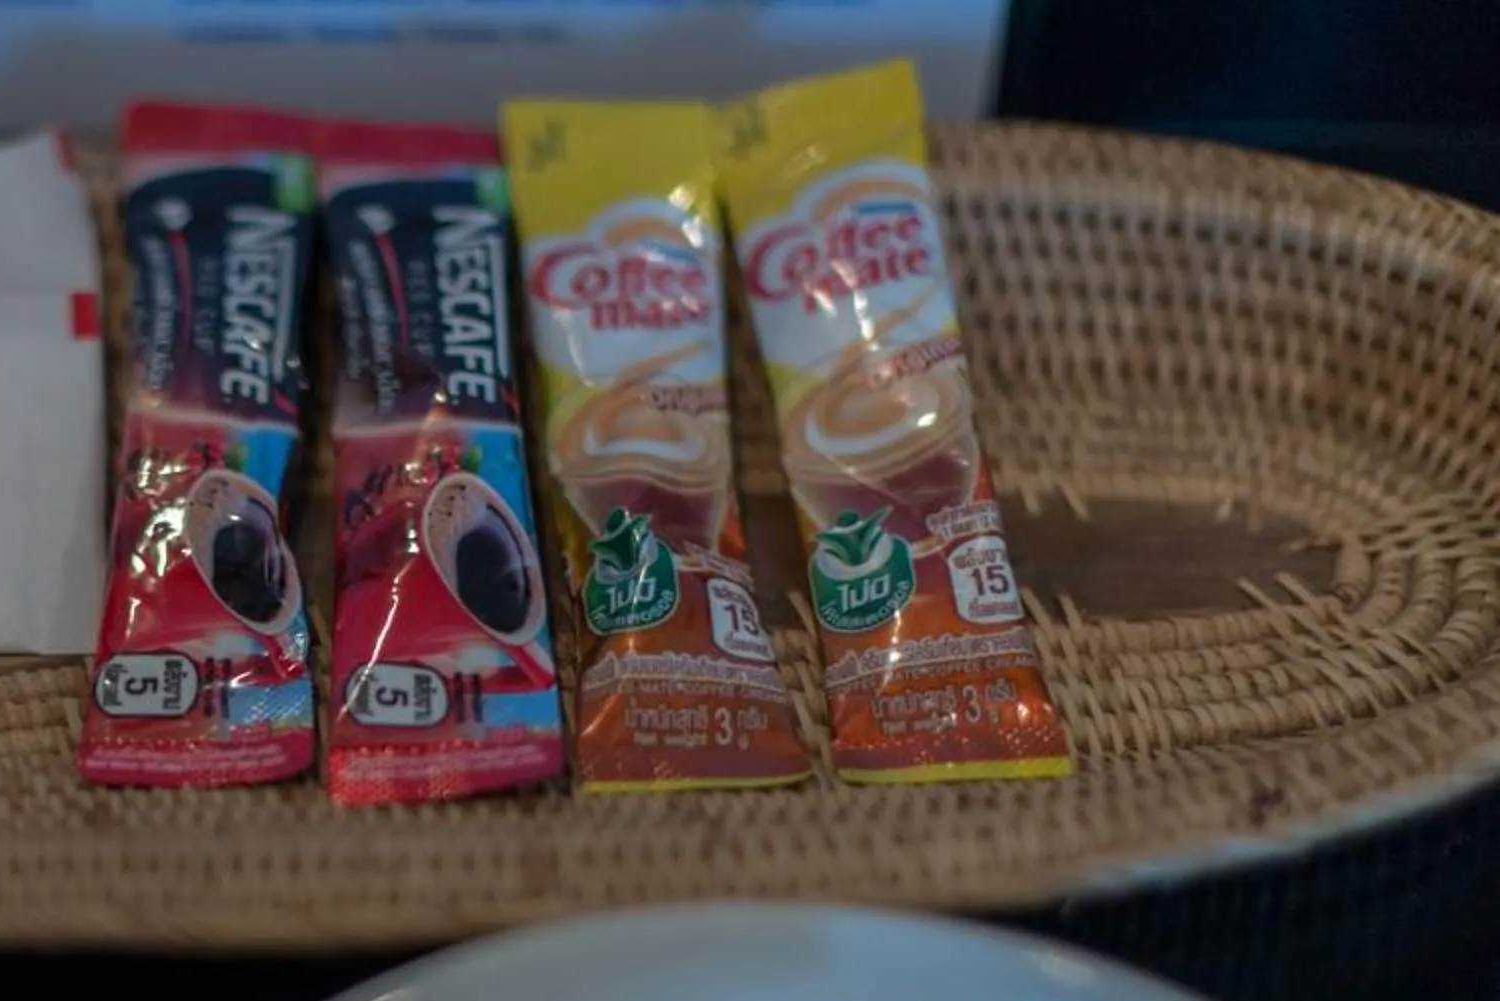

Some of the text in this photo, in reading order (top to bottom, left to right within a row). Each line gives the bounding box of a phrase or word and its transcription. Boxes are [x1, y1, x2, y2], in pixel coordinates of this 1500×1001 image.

[745, 213, 923, 301] Coffee
[972, 565, 1010, 596] 15
[724, 605, 759, 636] 15
[124, 677, 159, 695] 5
[376, 688, 410, 708] 5
[962, 684, 982, 724] 3
[714, 707, 733, 746] 3
